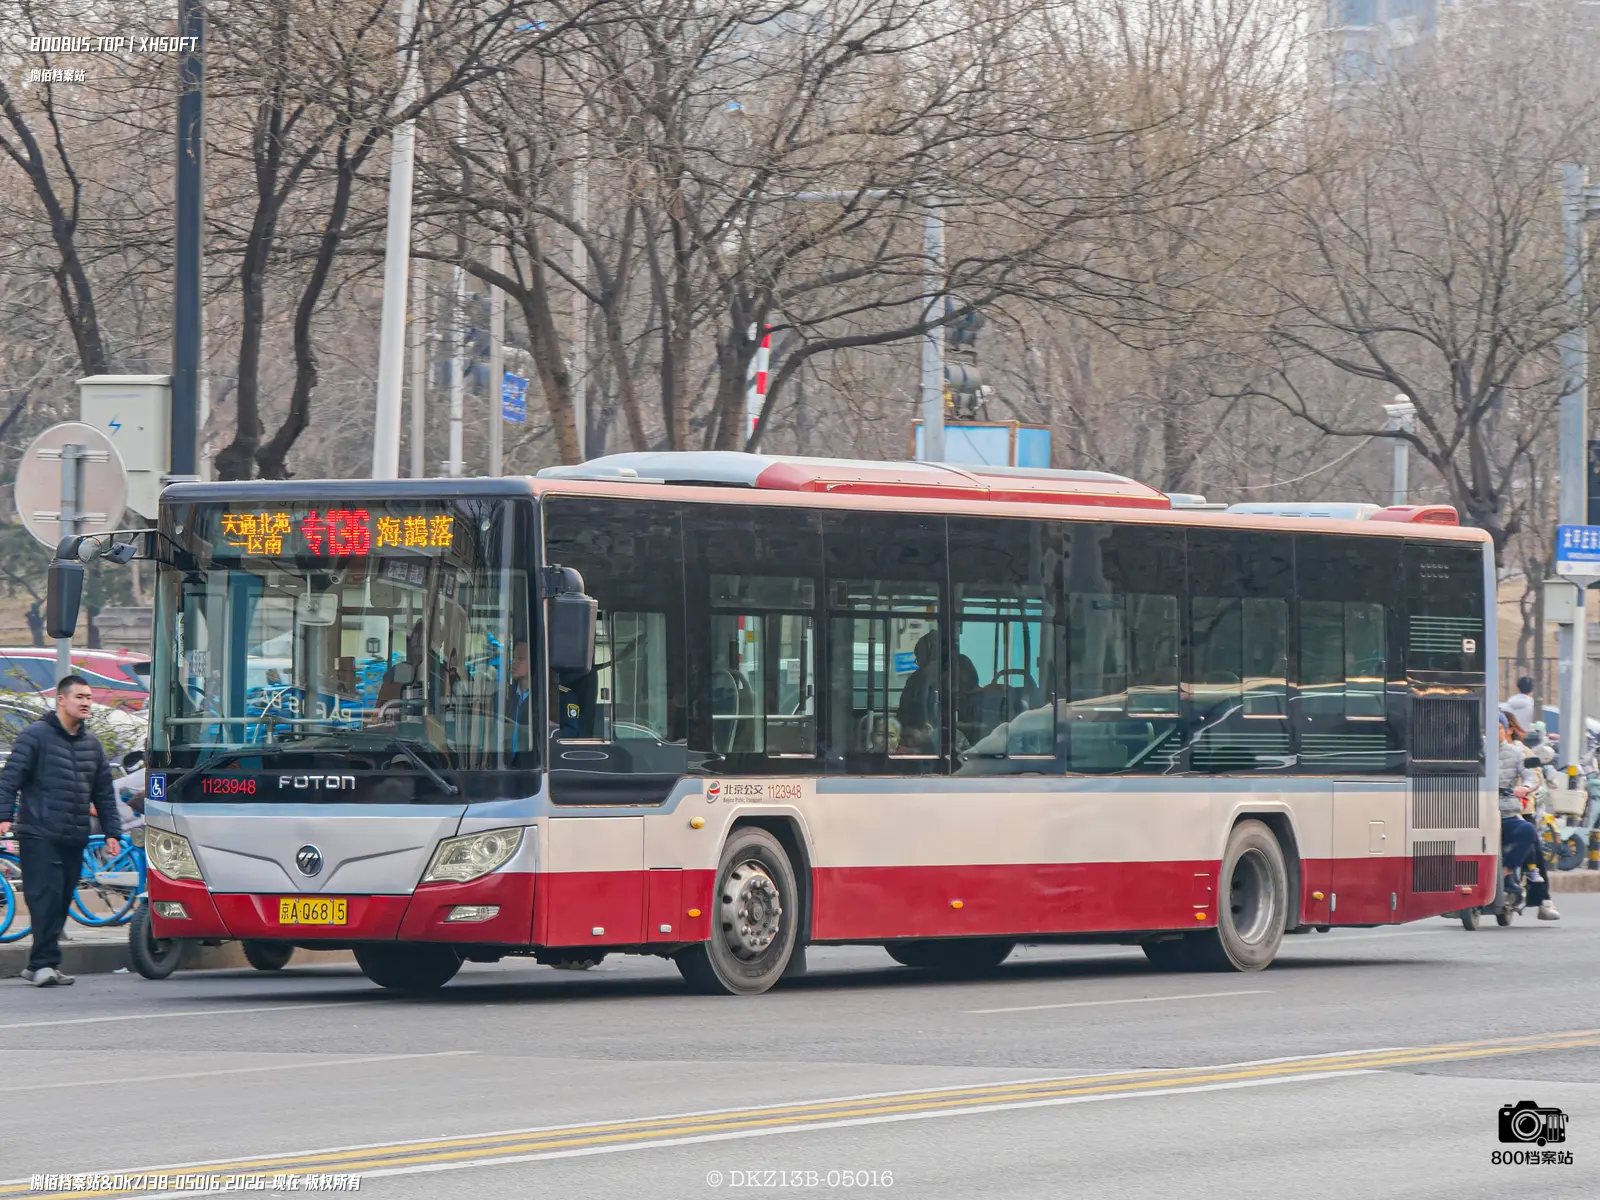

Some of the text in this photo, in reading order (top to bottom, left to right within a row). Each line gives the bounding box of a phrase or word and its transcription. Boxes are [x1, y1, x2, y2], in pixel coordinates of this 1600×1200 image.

[220, 512, 292, 535] 天通北苑
[299, 508, 371, 557] 专136
[228, 534, 283, 555] 一区南
[200, 778, 257, 795] 1123948
[278, 775, 356, 790] FOTON
[723, 784, 802, 799] 北京公交 1123948
